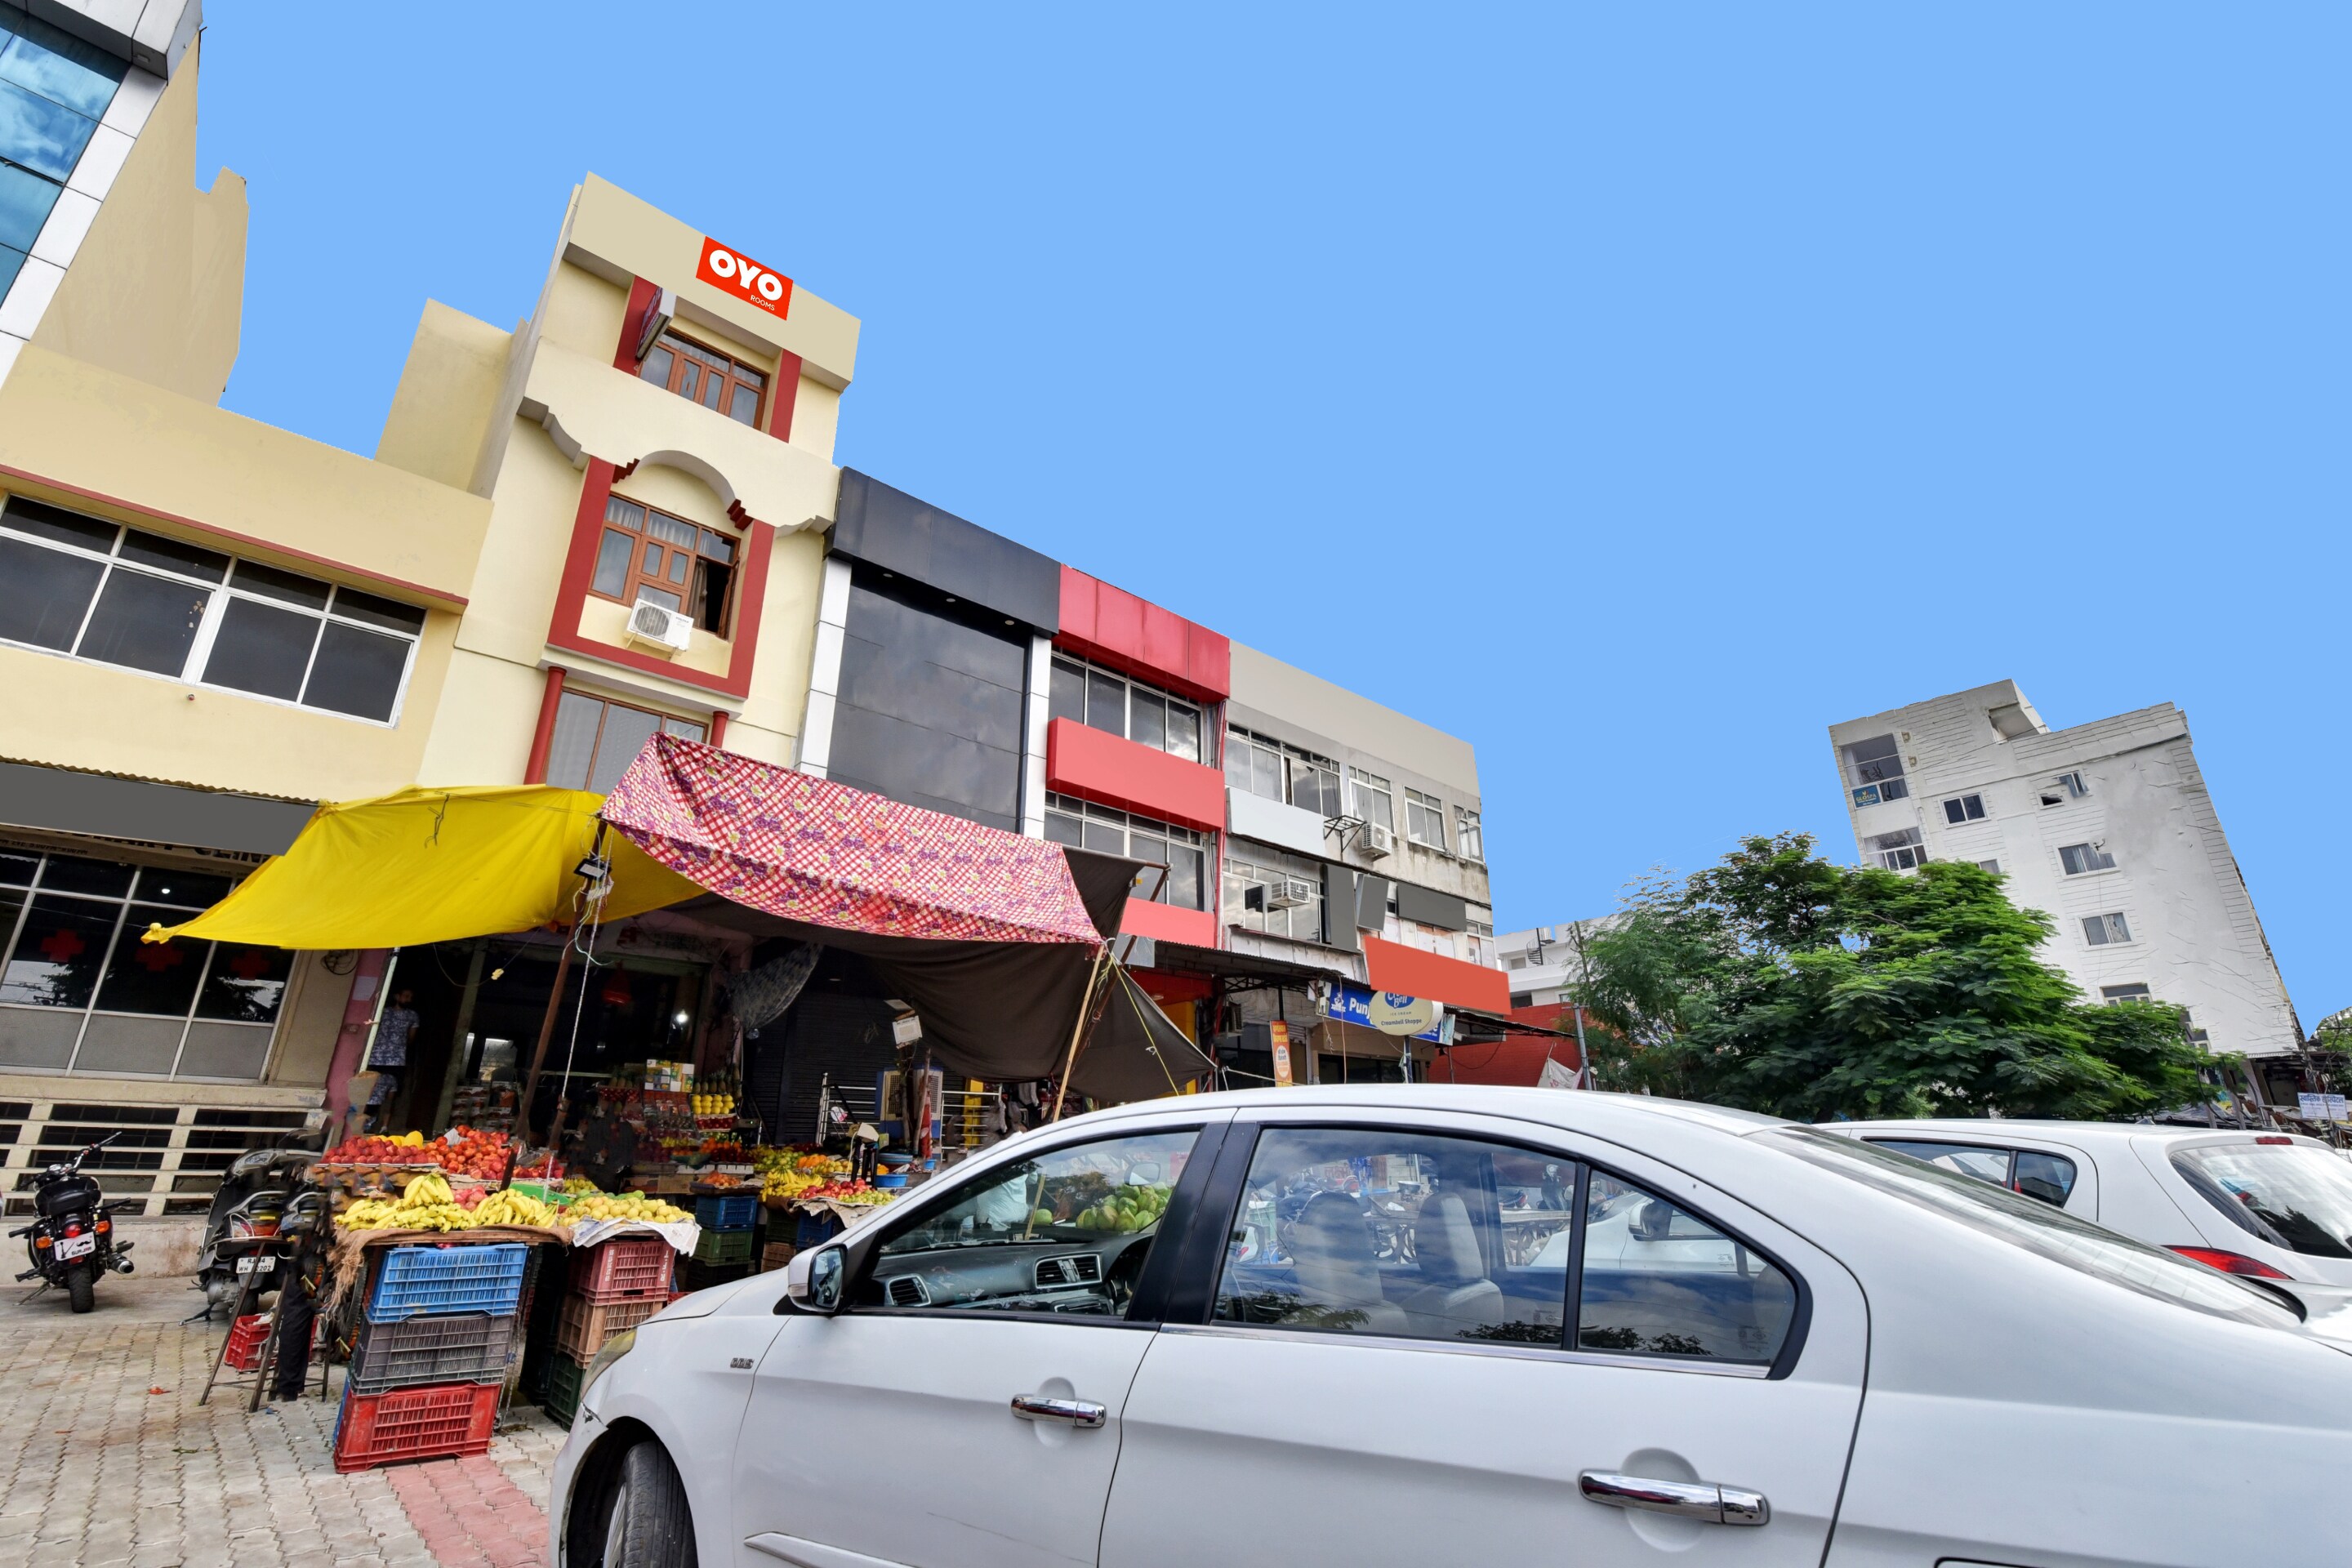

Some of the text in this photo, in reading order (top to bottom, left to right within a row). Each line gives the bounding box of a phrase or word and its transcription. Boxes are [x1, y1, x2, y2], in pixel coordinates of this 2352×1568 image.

[709, 249, 783, 301] OYO
[750, 294, 775, 311] ROOMS
[1393, 996, 1408, 1009] Bell
